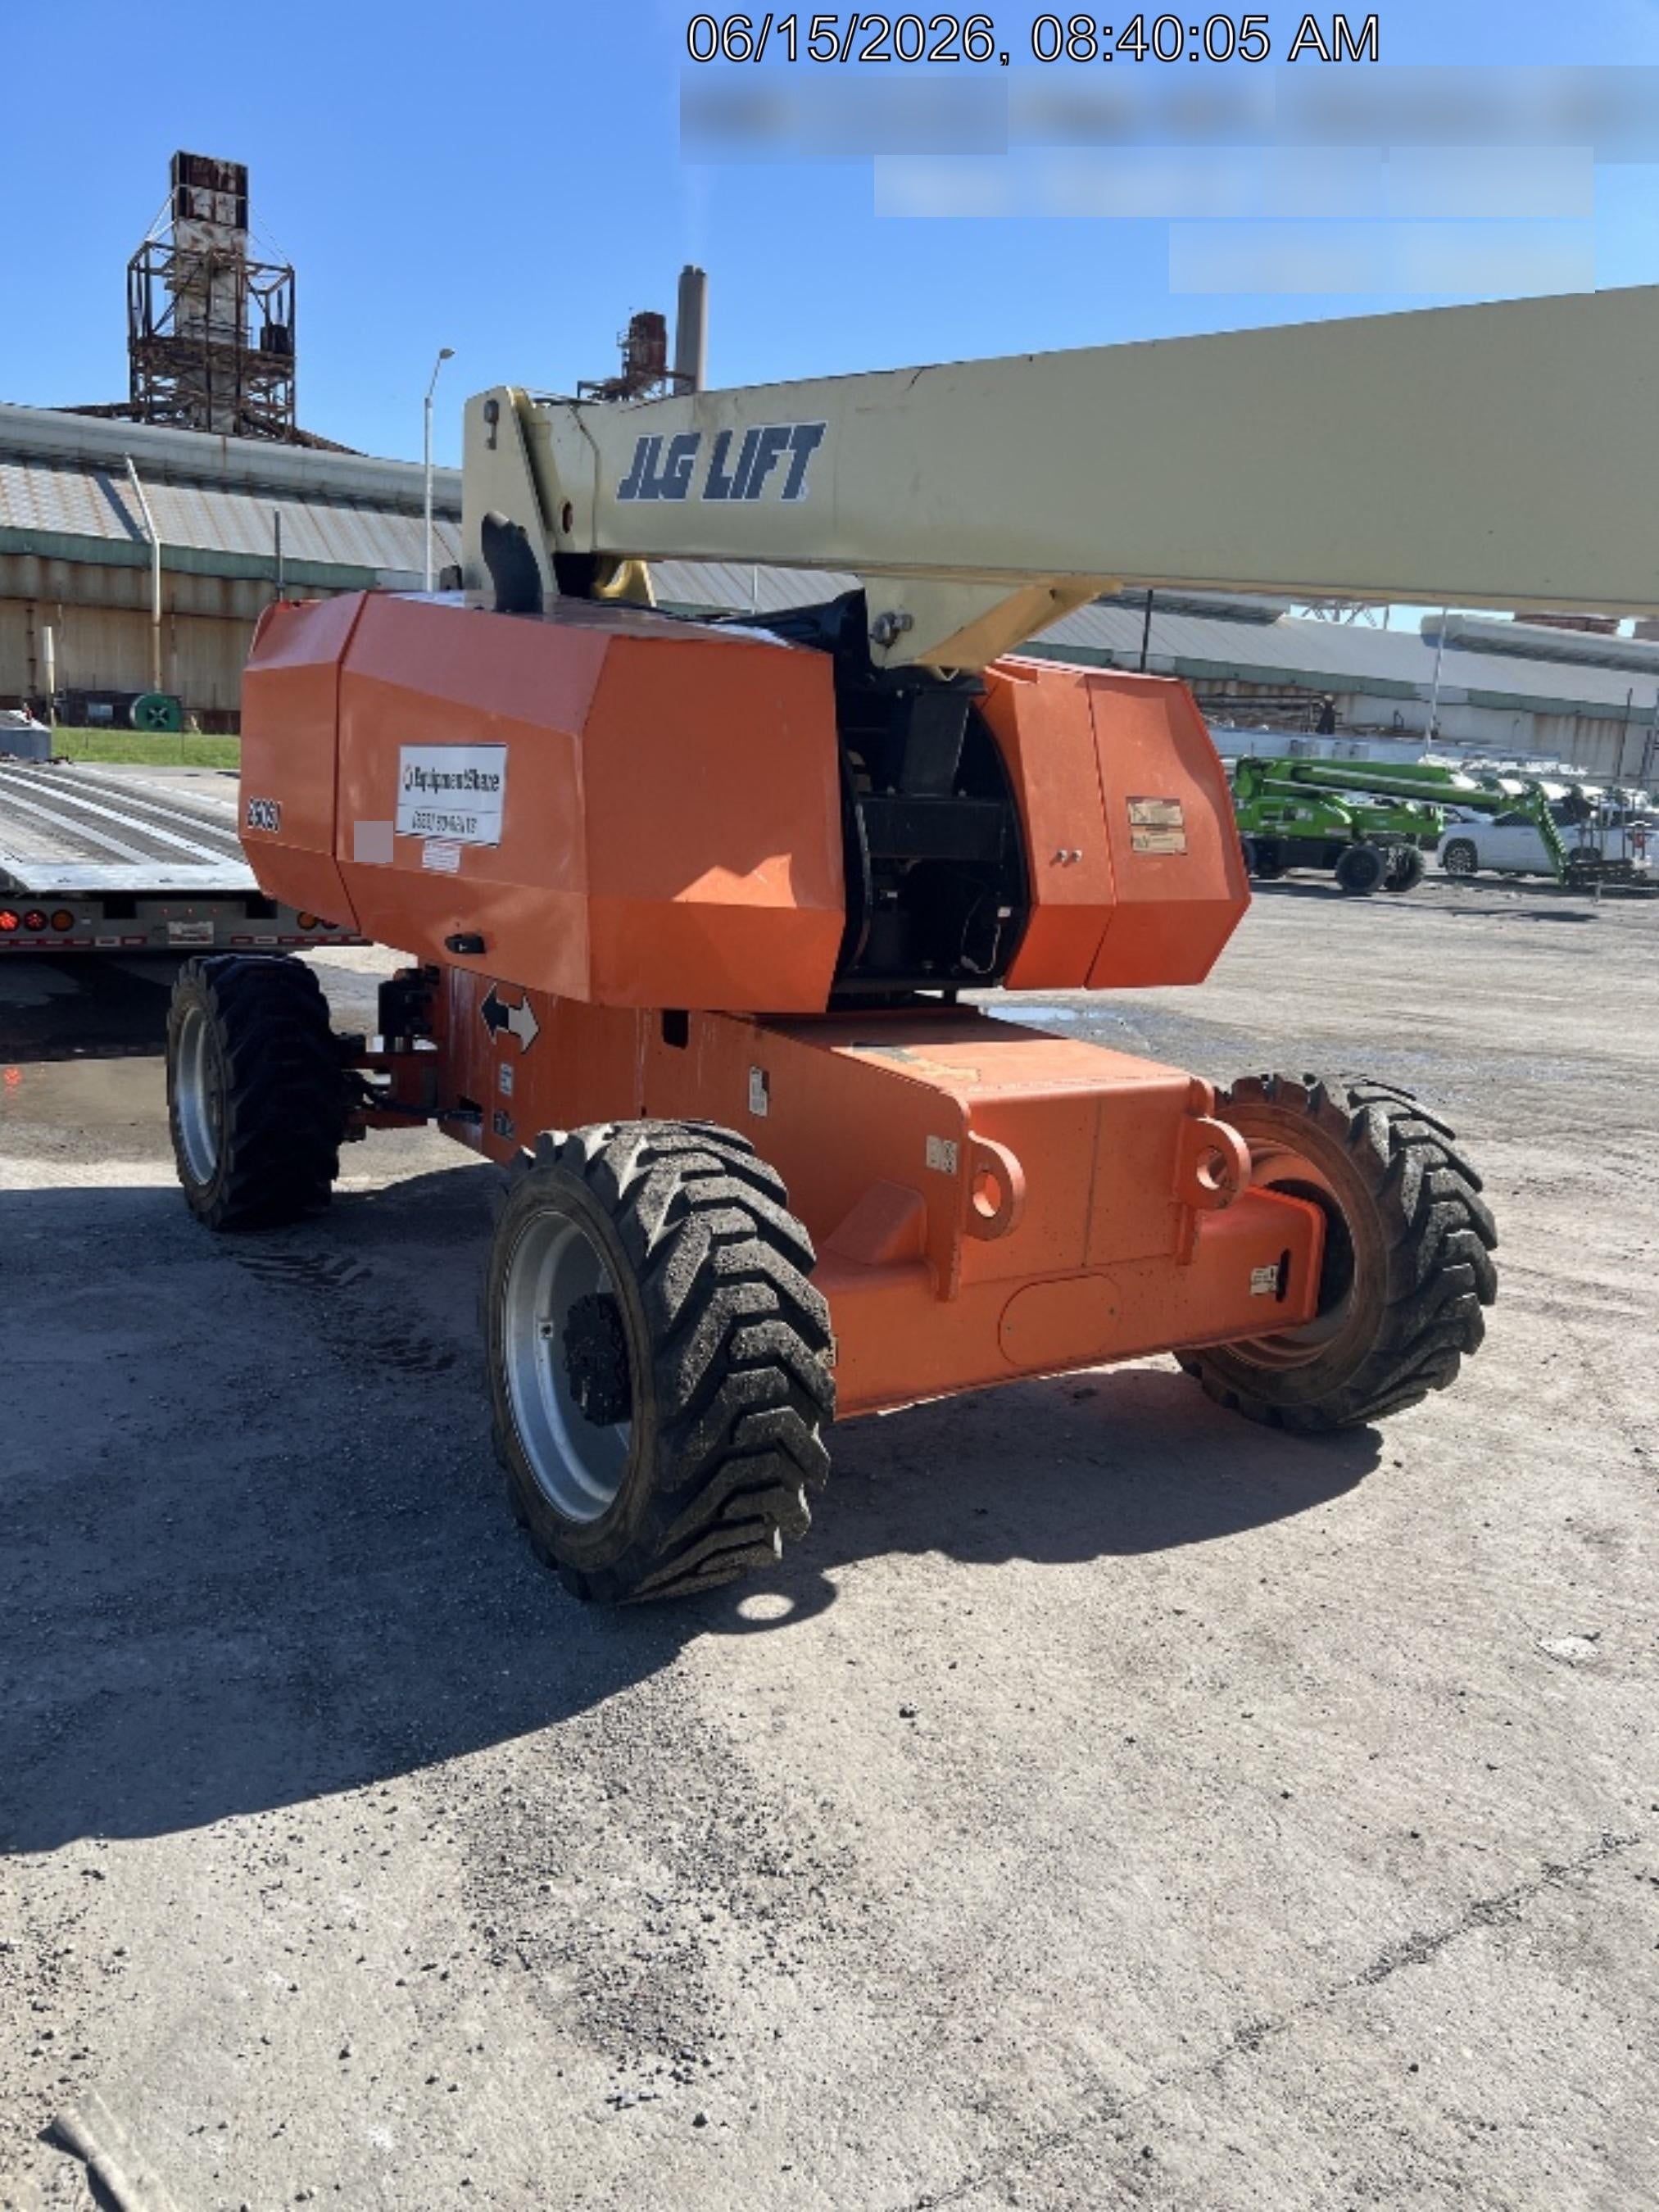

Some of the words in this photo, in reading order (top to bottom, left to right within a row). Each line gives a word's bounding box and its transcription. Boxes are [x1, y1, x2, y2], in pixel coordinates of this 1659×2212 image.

[616, 432, 701, 502] JLG
[701, 420, 827, 502] LIFT
[415, 766, 500, 794] EquipmentShare
